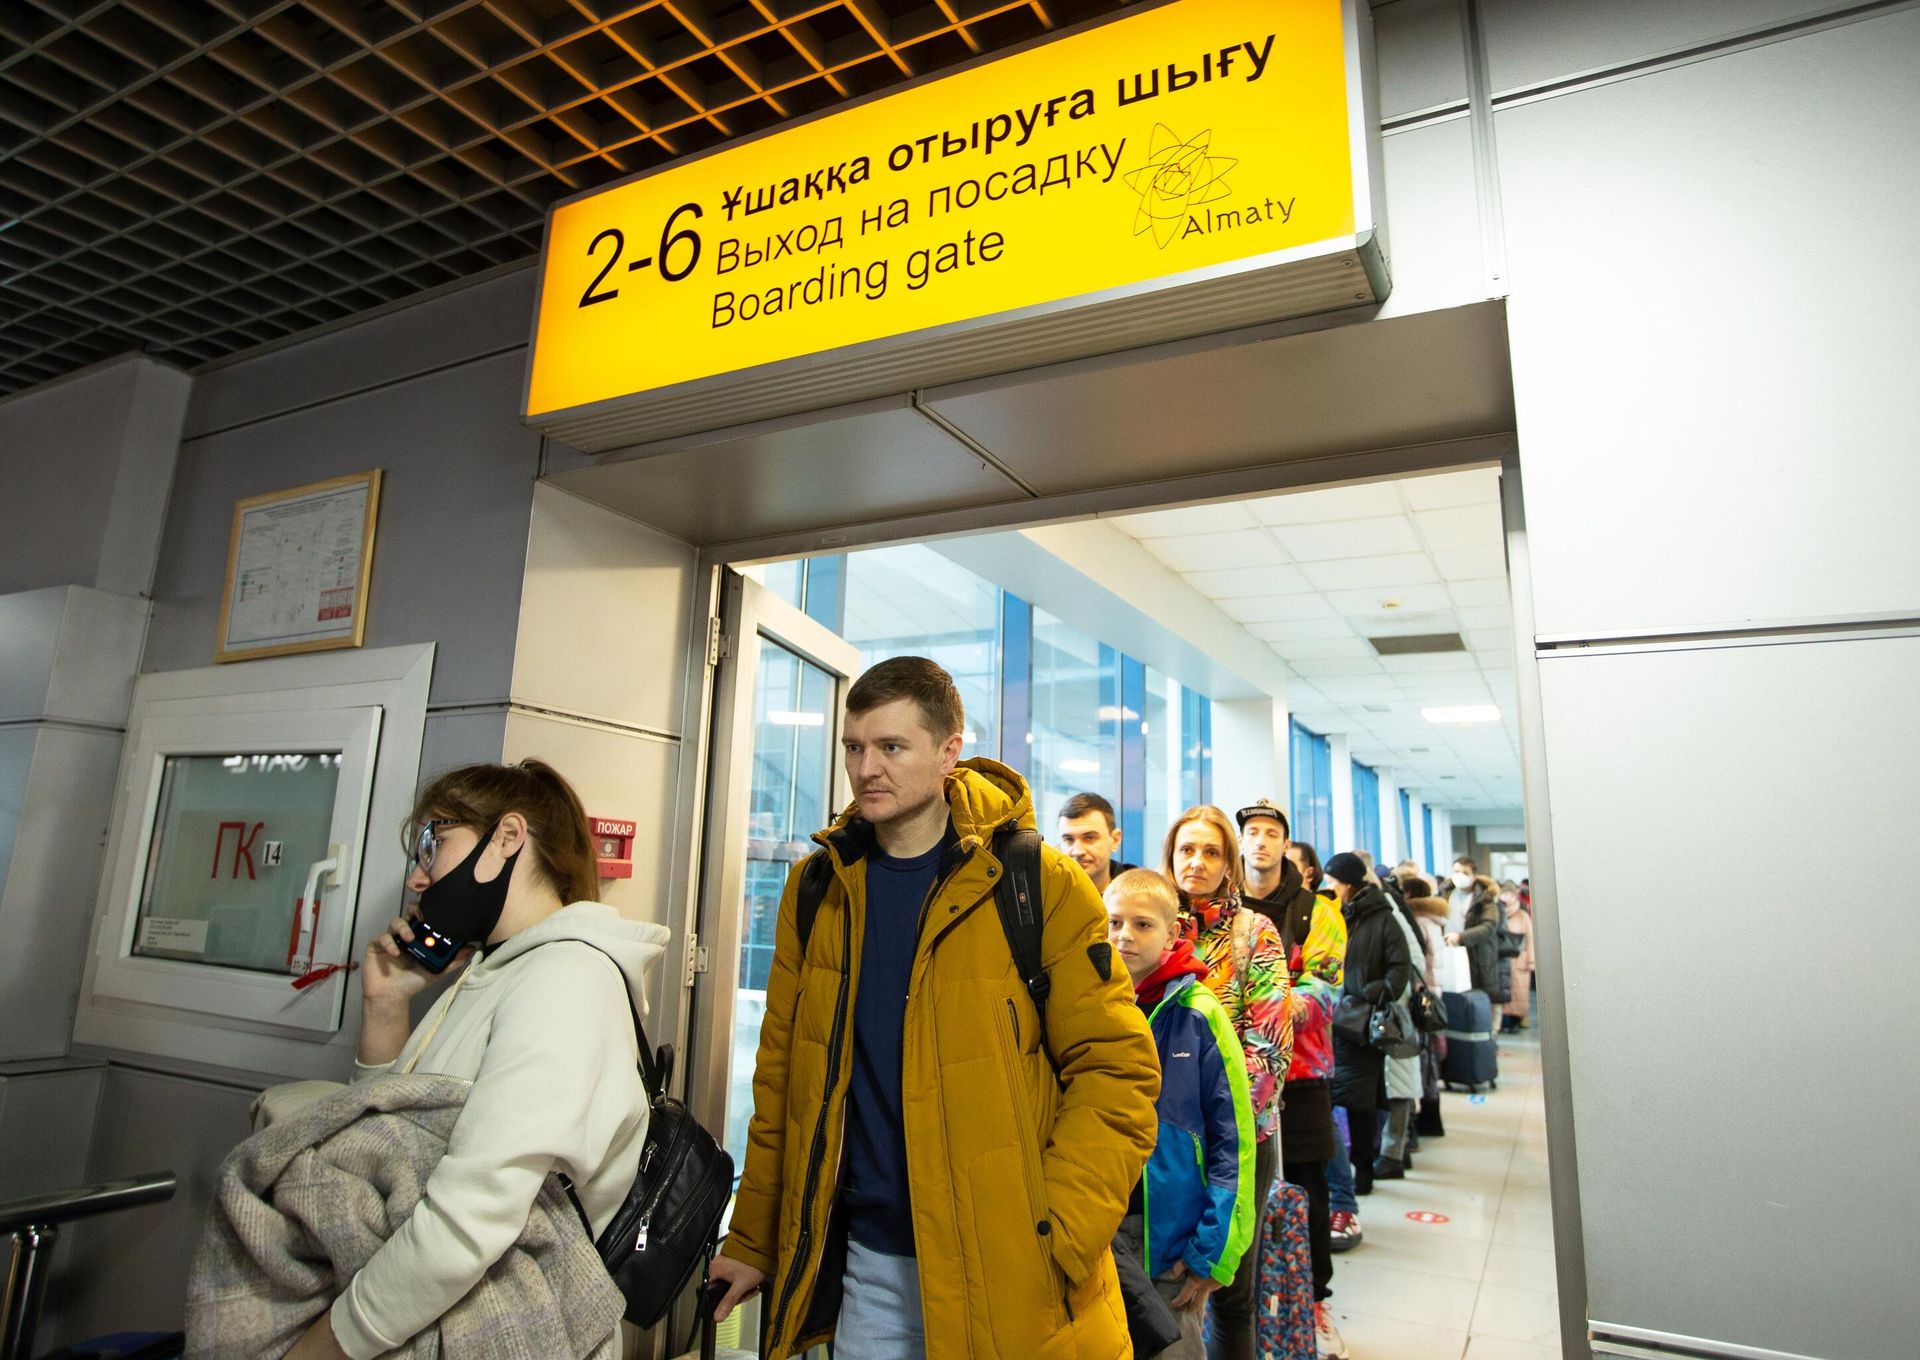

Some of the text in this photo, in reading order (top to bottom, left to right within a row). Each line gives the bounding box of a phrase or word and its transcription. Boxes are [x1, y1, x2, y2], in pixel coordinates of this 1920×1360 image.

[721, 34, 1276, 222] Ұшаққа отыруға шығу
[716, 138, 1126, 275] Выход на посадку
[1181, 197, 1296, 240] Almaty
[578, 202, 704, 309] 2-6
[711, 231, 1004, 329] Boarding gate
[211, 821, 265, 880] ПК
[264, 843, 282, 864] 14
[597, 821, 633, 836] ПОЖАР
